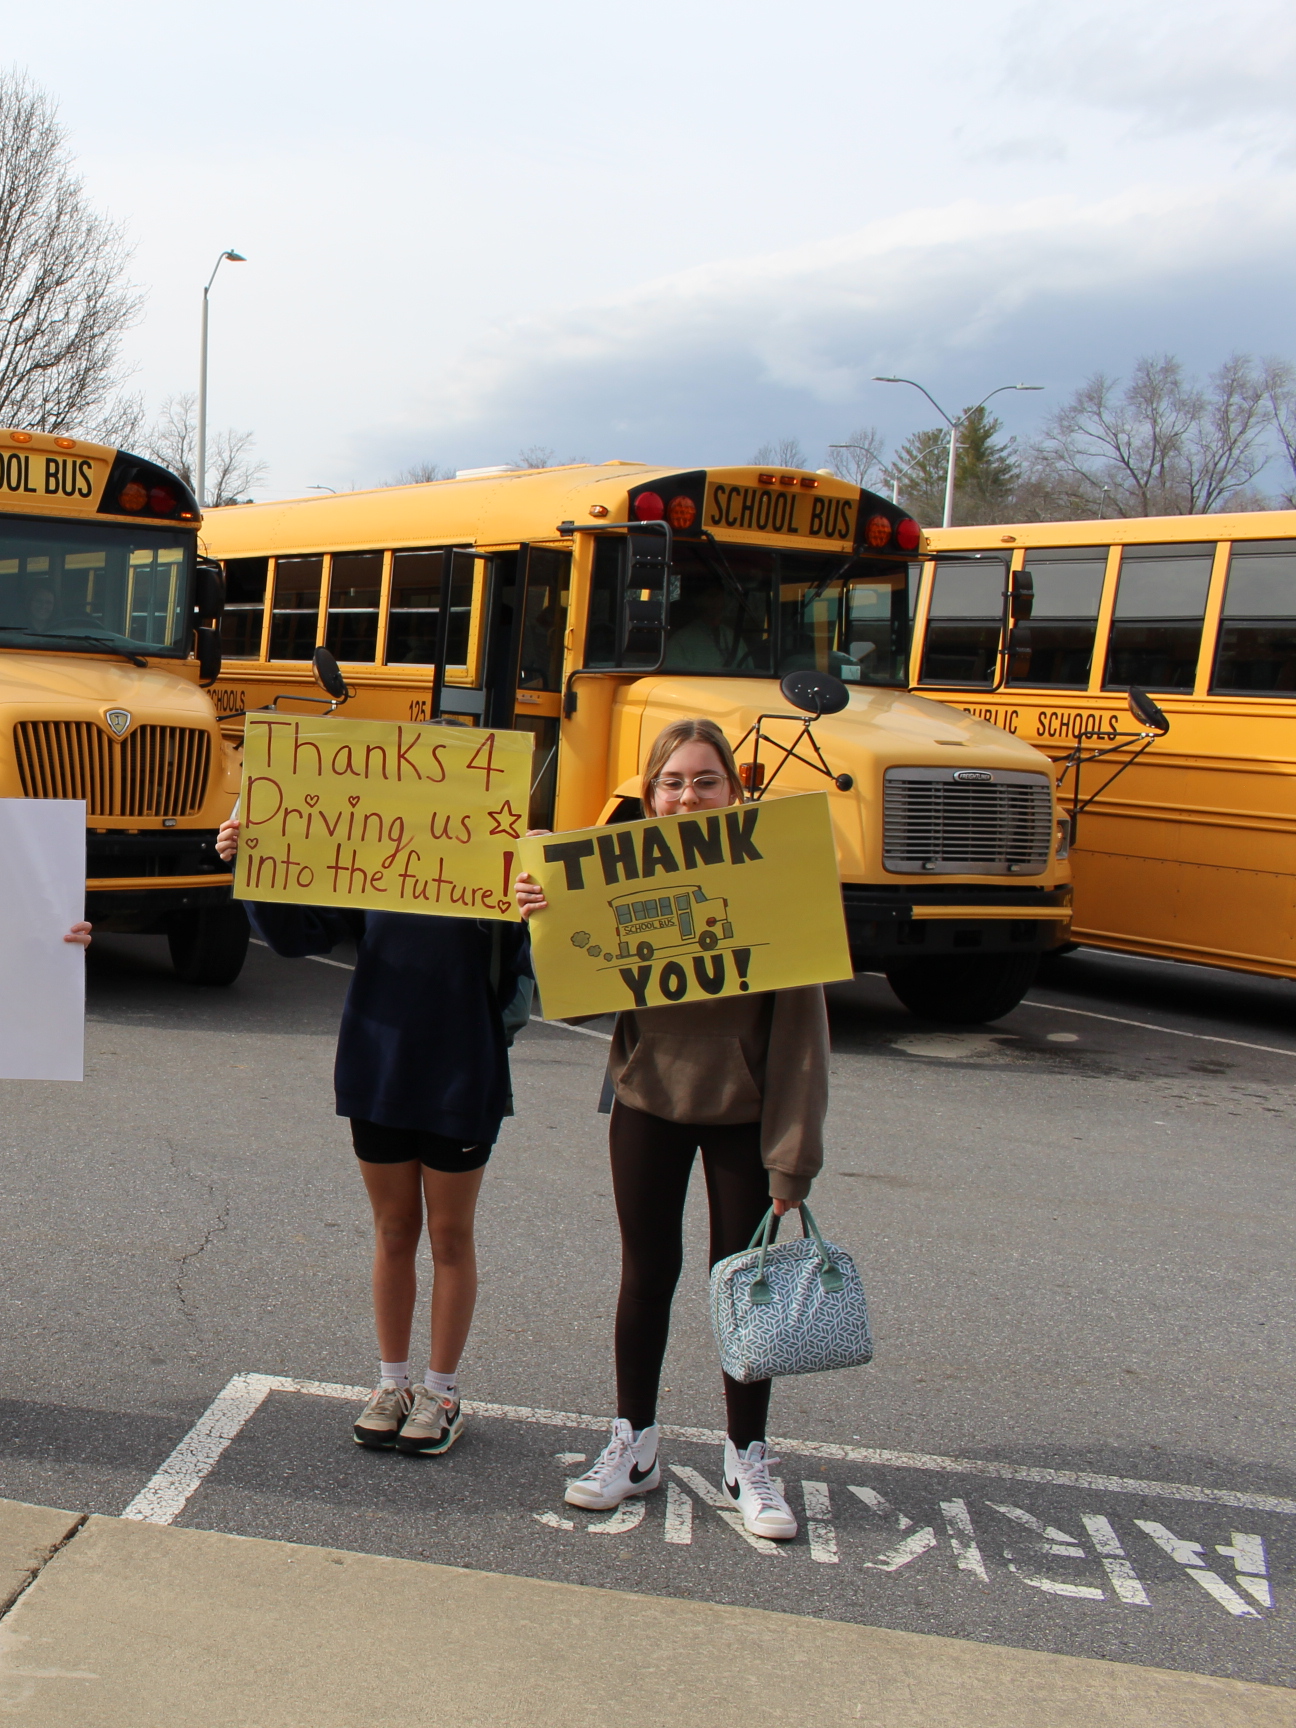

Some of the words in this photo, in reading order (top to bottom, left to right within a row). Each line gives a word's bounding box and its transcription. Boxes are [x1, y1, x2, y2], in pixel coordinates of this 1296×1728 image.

[44, 457, 93, 498] BUS
[710, 485, 799, 533] SCHOOL
[809, 497, 853, 539] BUS
[409, 700, 426, 722] 125
[1037, 711, 1119, 741] SCHOOLS
[466, 733, 505, 792] 4
[245, 776, 415, 869] Driving
[430, 811, 471, 844] us
[542, 807, 764, 891] THANK
[245, 838, 314, 890] into
[327, 843, 388, 894] the
[398, 849, 514, 913] future!
[623, 921, 658, 935] SCHOOL
[658, 918, 675, 929] BUS
[619, 948, 752, 1008] YOU!
[535, 1453, 1276, 1618] ARKING
